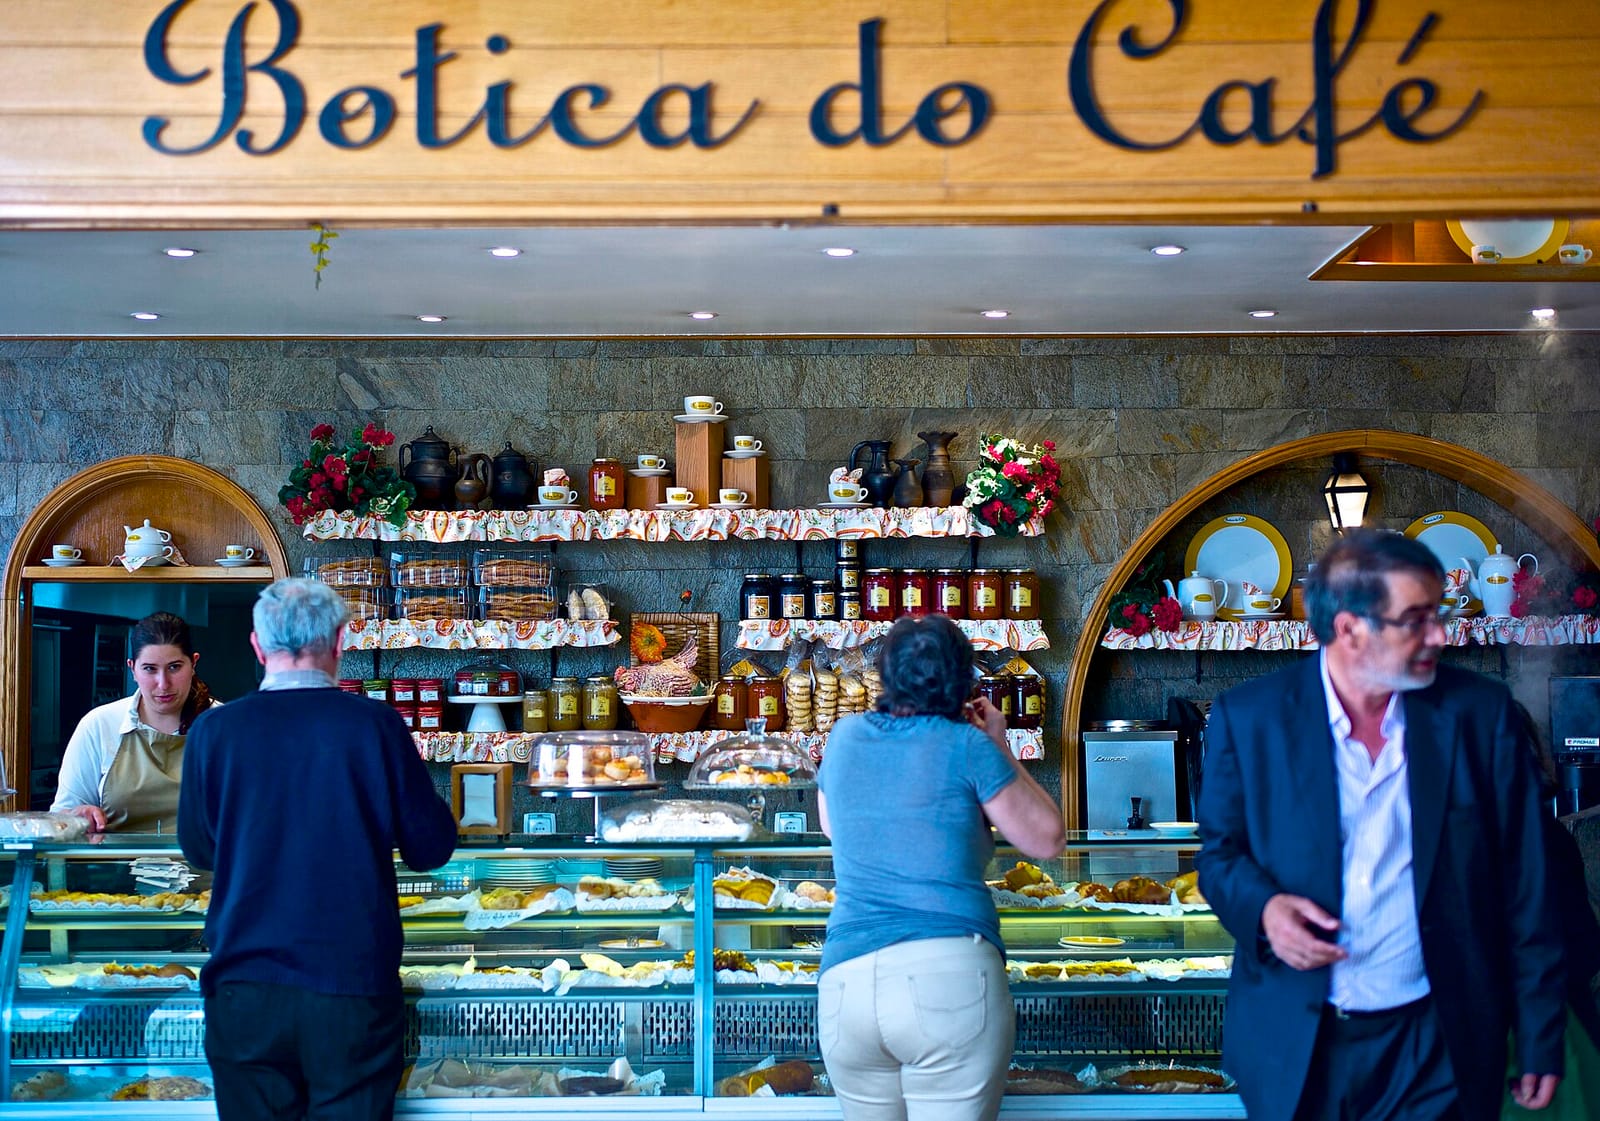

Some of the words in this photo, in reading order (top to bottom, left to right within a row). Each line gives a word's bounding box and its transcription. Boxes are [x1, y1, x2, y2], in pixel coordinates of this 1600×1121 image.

[141, 0, 763, 156] Botica
[808, 18, 996, 147] do
[1068, 0, 1487, 180] Café
